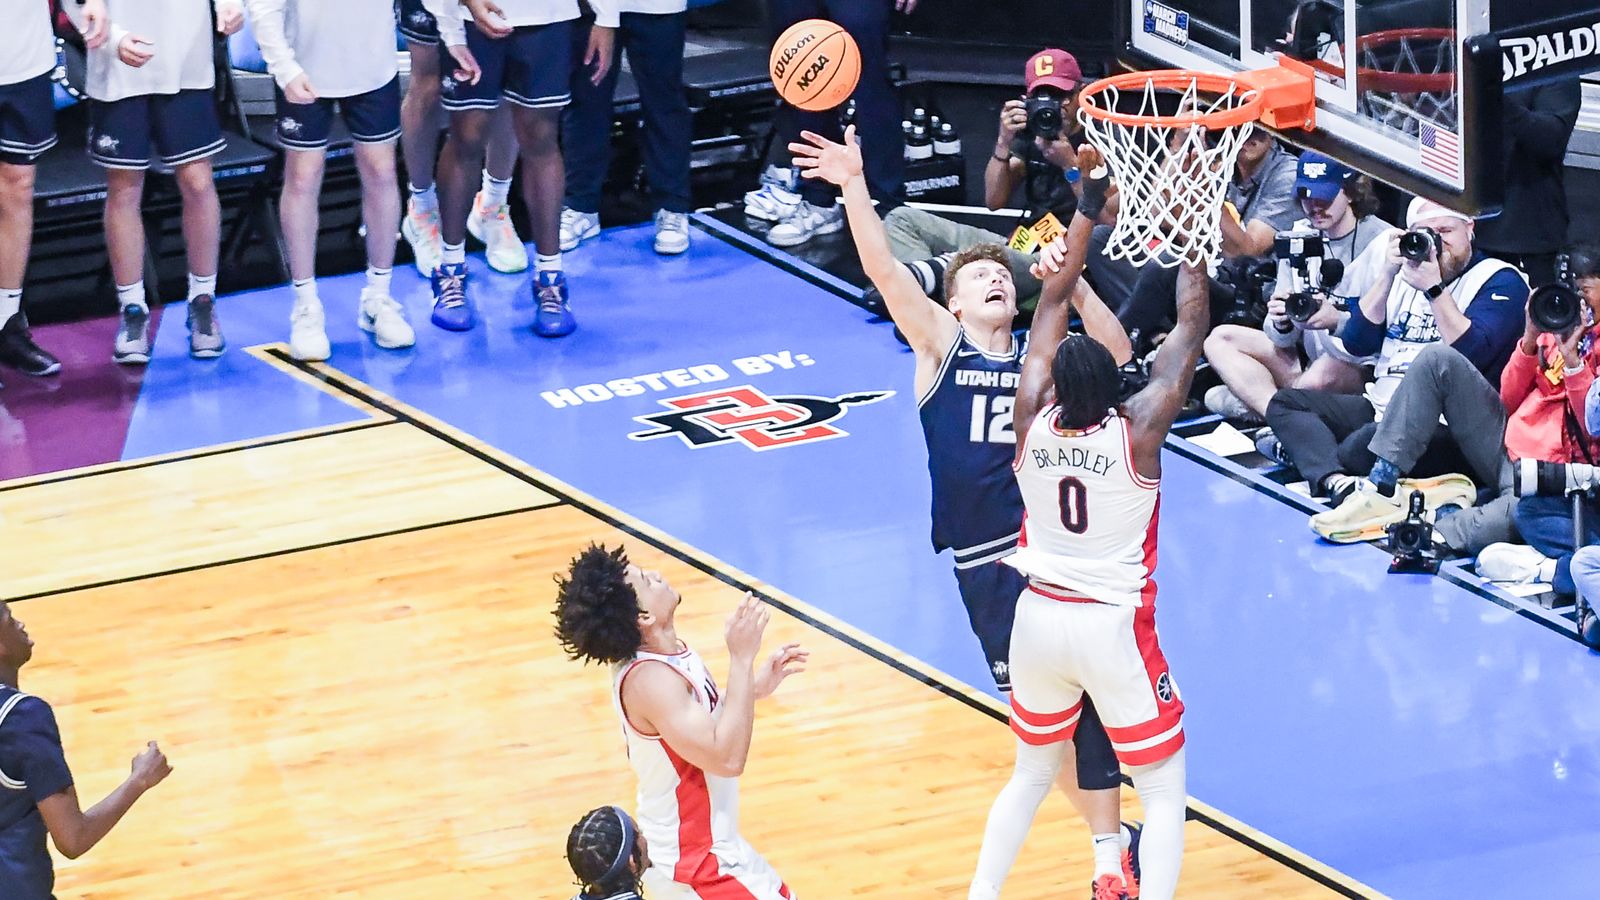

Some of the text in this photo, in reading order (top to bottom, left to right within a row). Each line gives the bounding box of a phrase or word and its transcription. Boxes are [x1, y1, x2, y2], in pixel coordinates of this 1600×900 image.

[774, 33, 817, 80] Wilson
[796, 54, 830, 92] NCAA
[1035, 55, 1054, 77] C
[540, 350, 816, 409] HOSTED BY:
[955, 369, 1021, 389] UTAH ST
[969, 393, 1018, 444] 12
[1032, 447, 1117, 477] BRADLEY
[1058, 475, 1089, 535] 0
